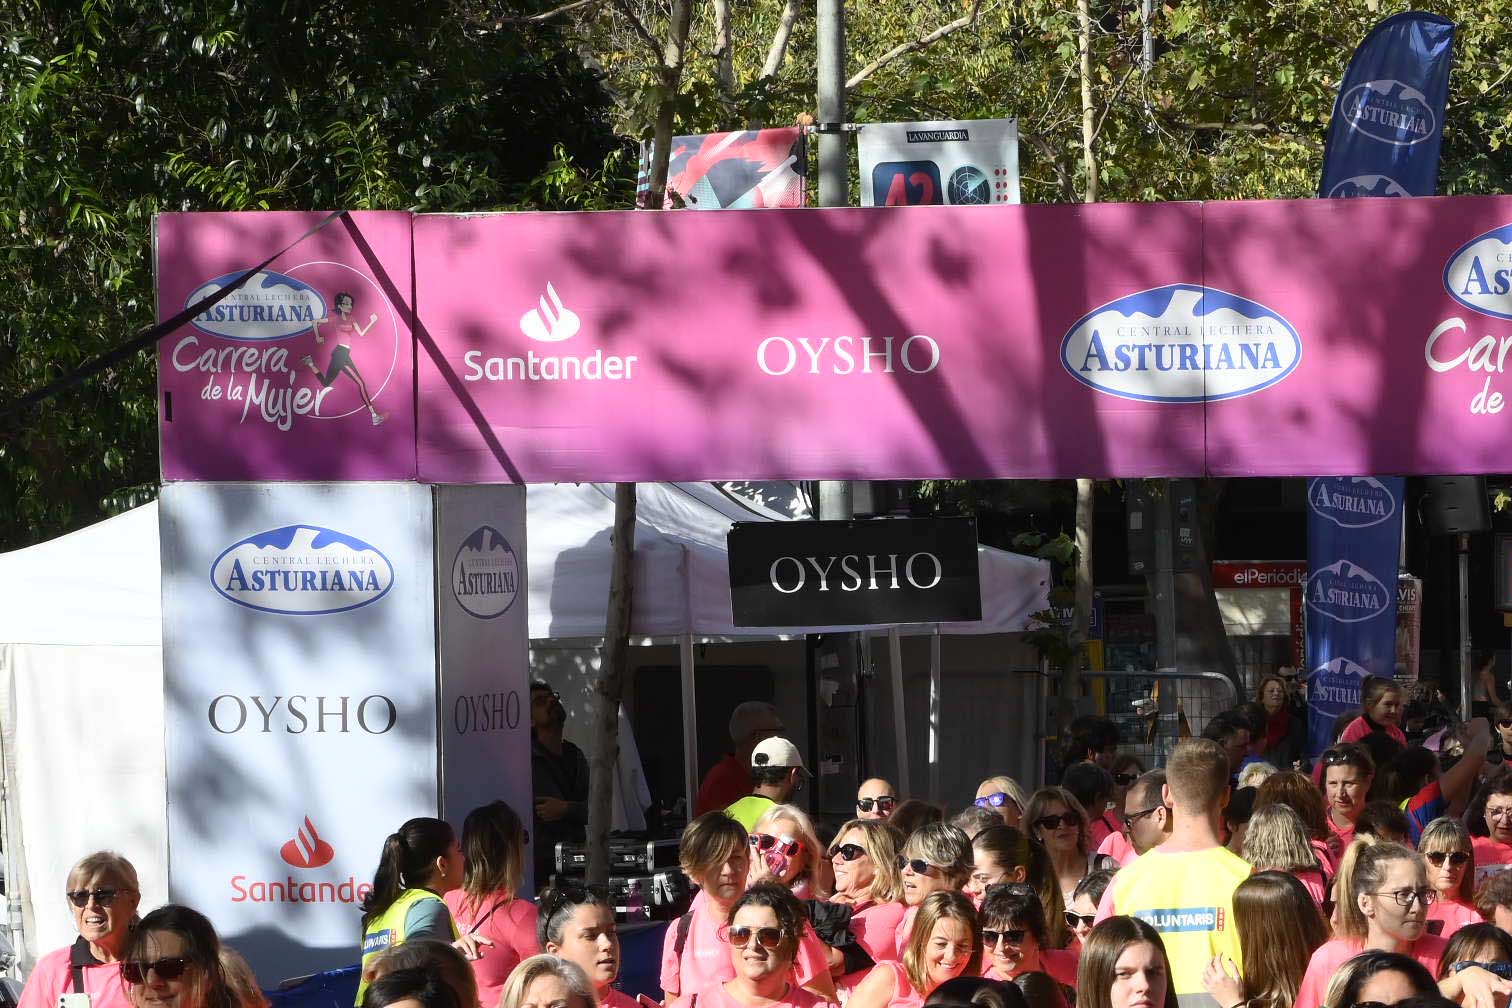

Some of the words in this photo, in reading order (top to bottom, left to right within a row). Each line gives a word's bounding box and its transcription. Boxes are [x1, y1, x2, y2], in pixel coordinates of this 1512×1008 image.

[196, 296, 315, 322] ASTURIANA
[1116, 325, 1193, 337] CENTRAL
[172, 336, 289, 373] Carrera
[464, 350, 637, 381] Santander
[756, 335, 940, 375] OYSHO
[1081, 329, 1283, 373] ASTURIANA
[201, 374, 222, 400] de
[227, 374, 242, 400] la
[240, 371, 334, 432] Mujer
[1470, 376, 1504, 414] de
[225, 559, 382, 592] ASTURIANA
[253, 556, 308, 566] CENTRAL
[769, 552, 943, 594] OYSHO
[1234, 568, 1307, 586] elPeriódi
[457, 571, 515, 596] ASTURIANA
[207, 694, 398, 735] OYSHO
[454, 690, 520, 736] OYSHO
[231, 875, 370, 903] Santande
[1140, 912, 1215, 927] OLUNTARIS
